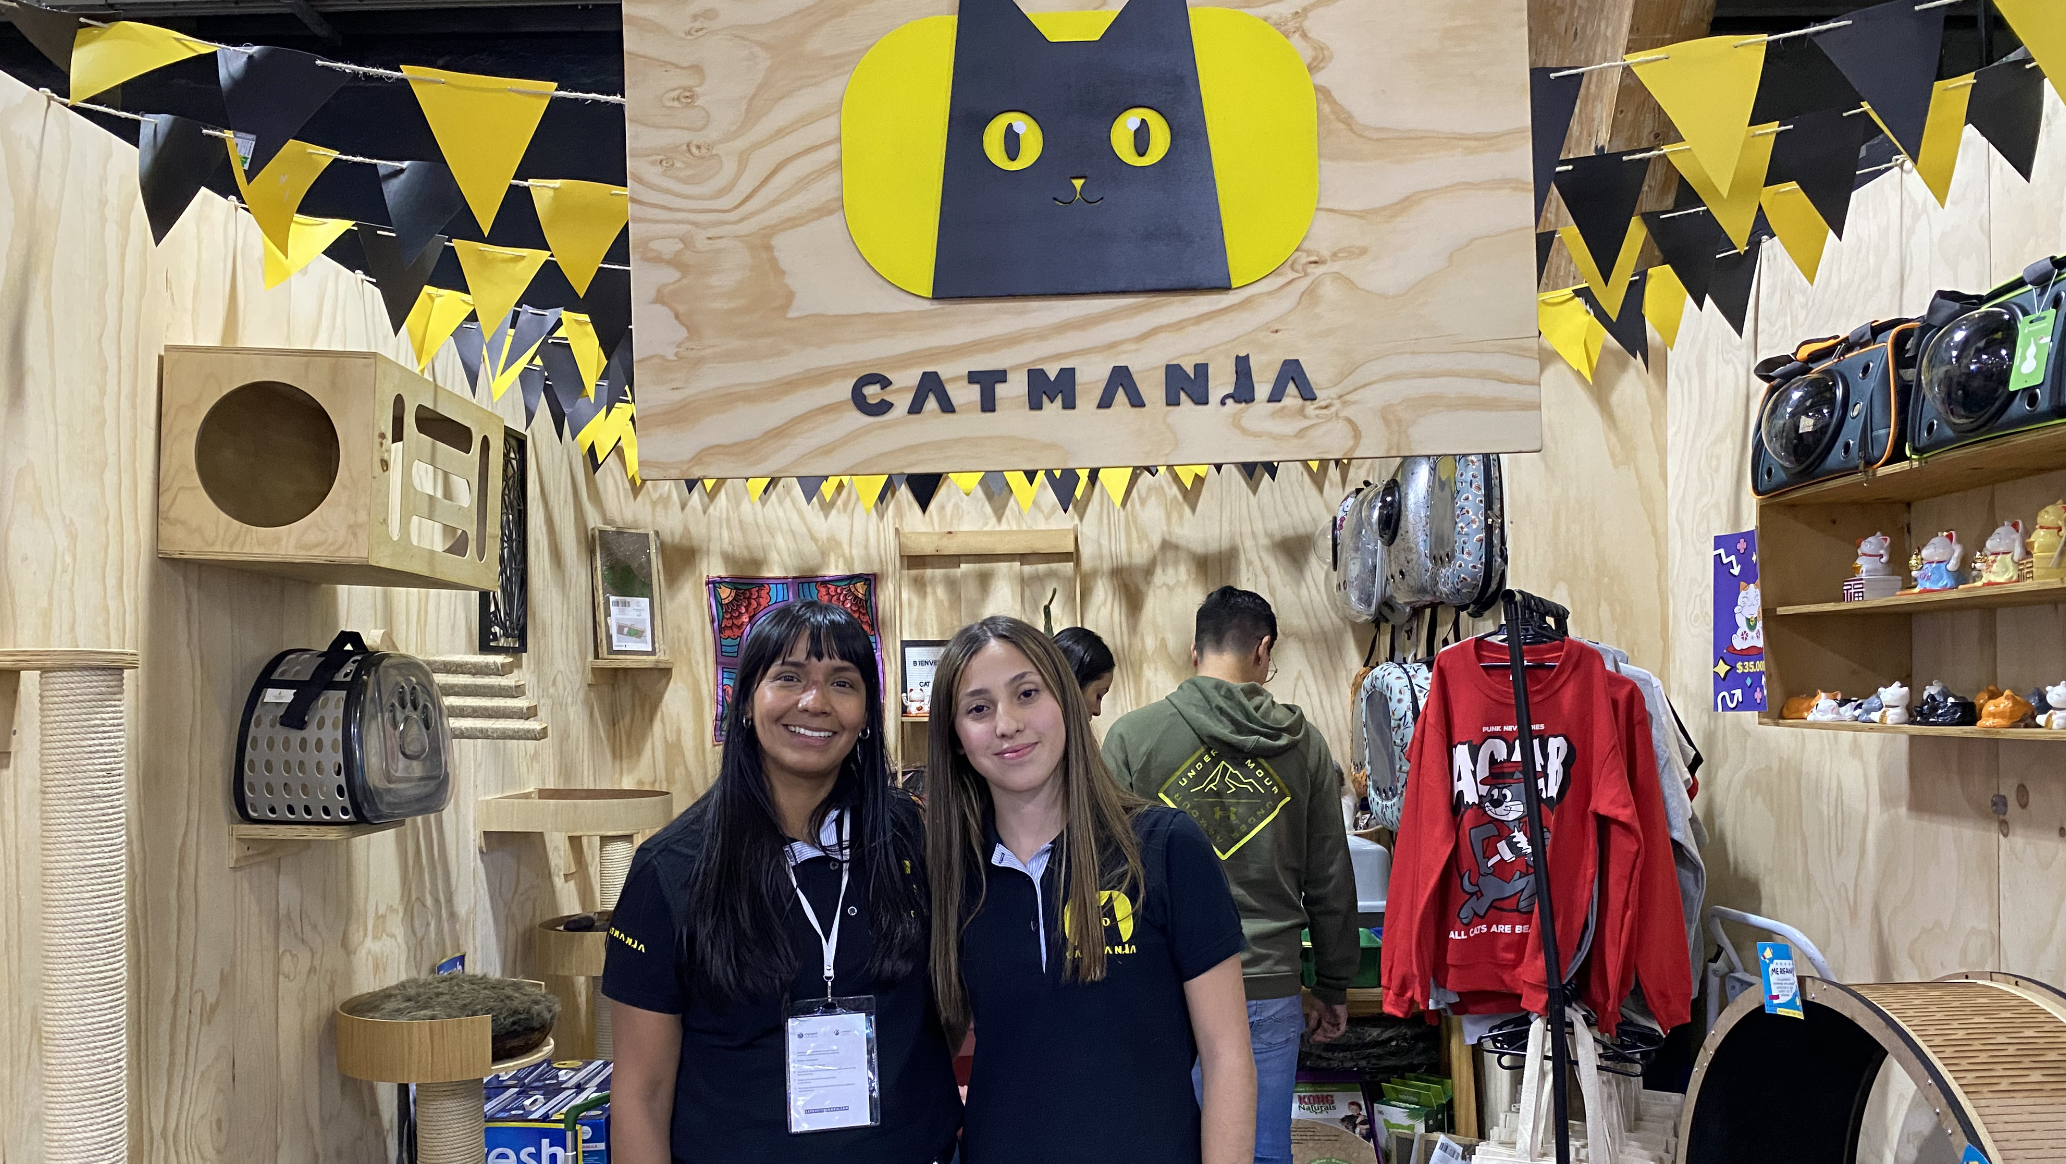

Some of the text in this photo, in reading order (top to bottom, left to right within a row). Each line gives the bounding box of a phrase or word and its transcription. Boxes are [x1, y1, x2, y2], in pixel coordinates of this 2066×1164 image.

[1244, 758, 1279, 795] MOUR
[1452, 736, 1568, 806] ACAB
[1448, 930, 1468, 940] ALL
[1469, 924, 1487, 937] CATS
[1490, 924, 1512, 934] ARE
[1297, 1093, 1335, 1106] KONG
[1298, 1104, 1337, 1113] Naturals
